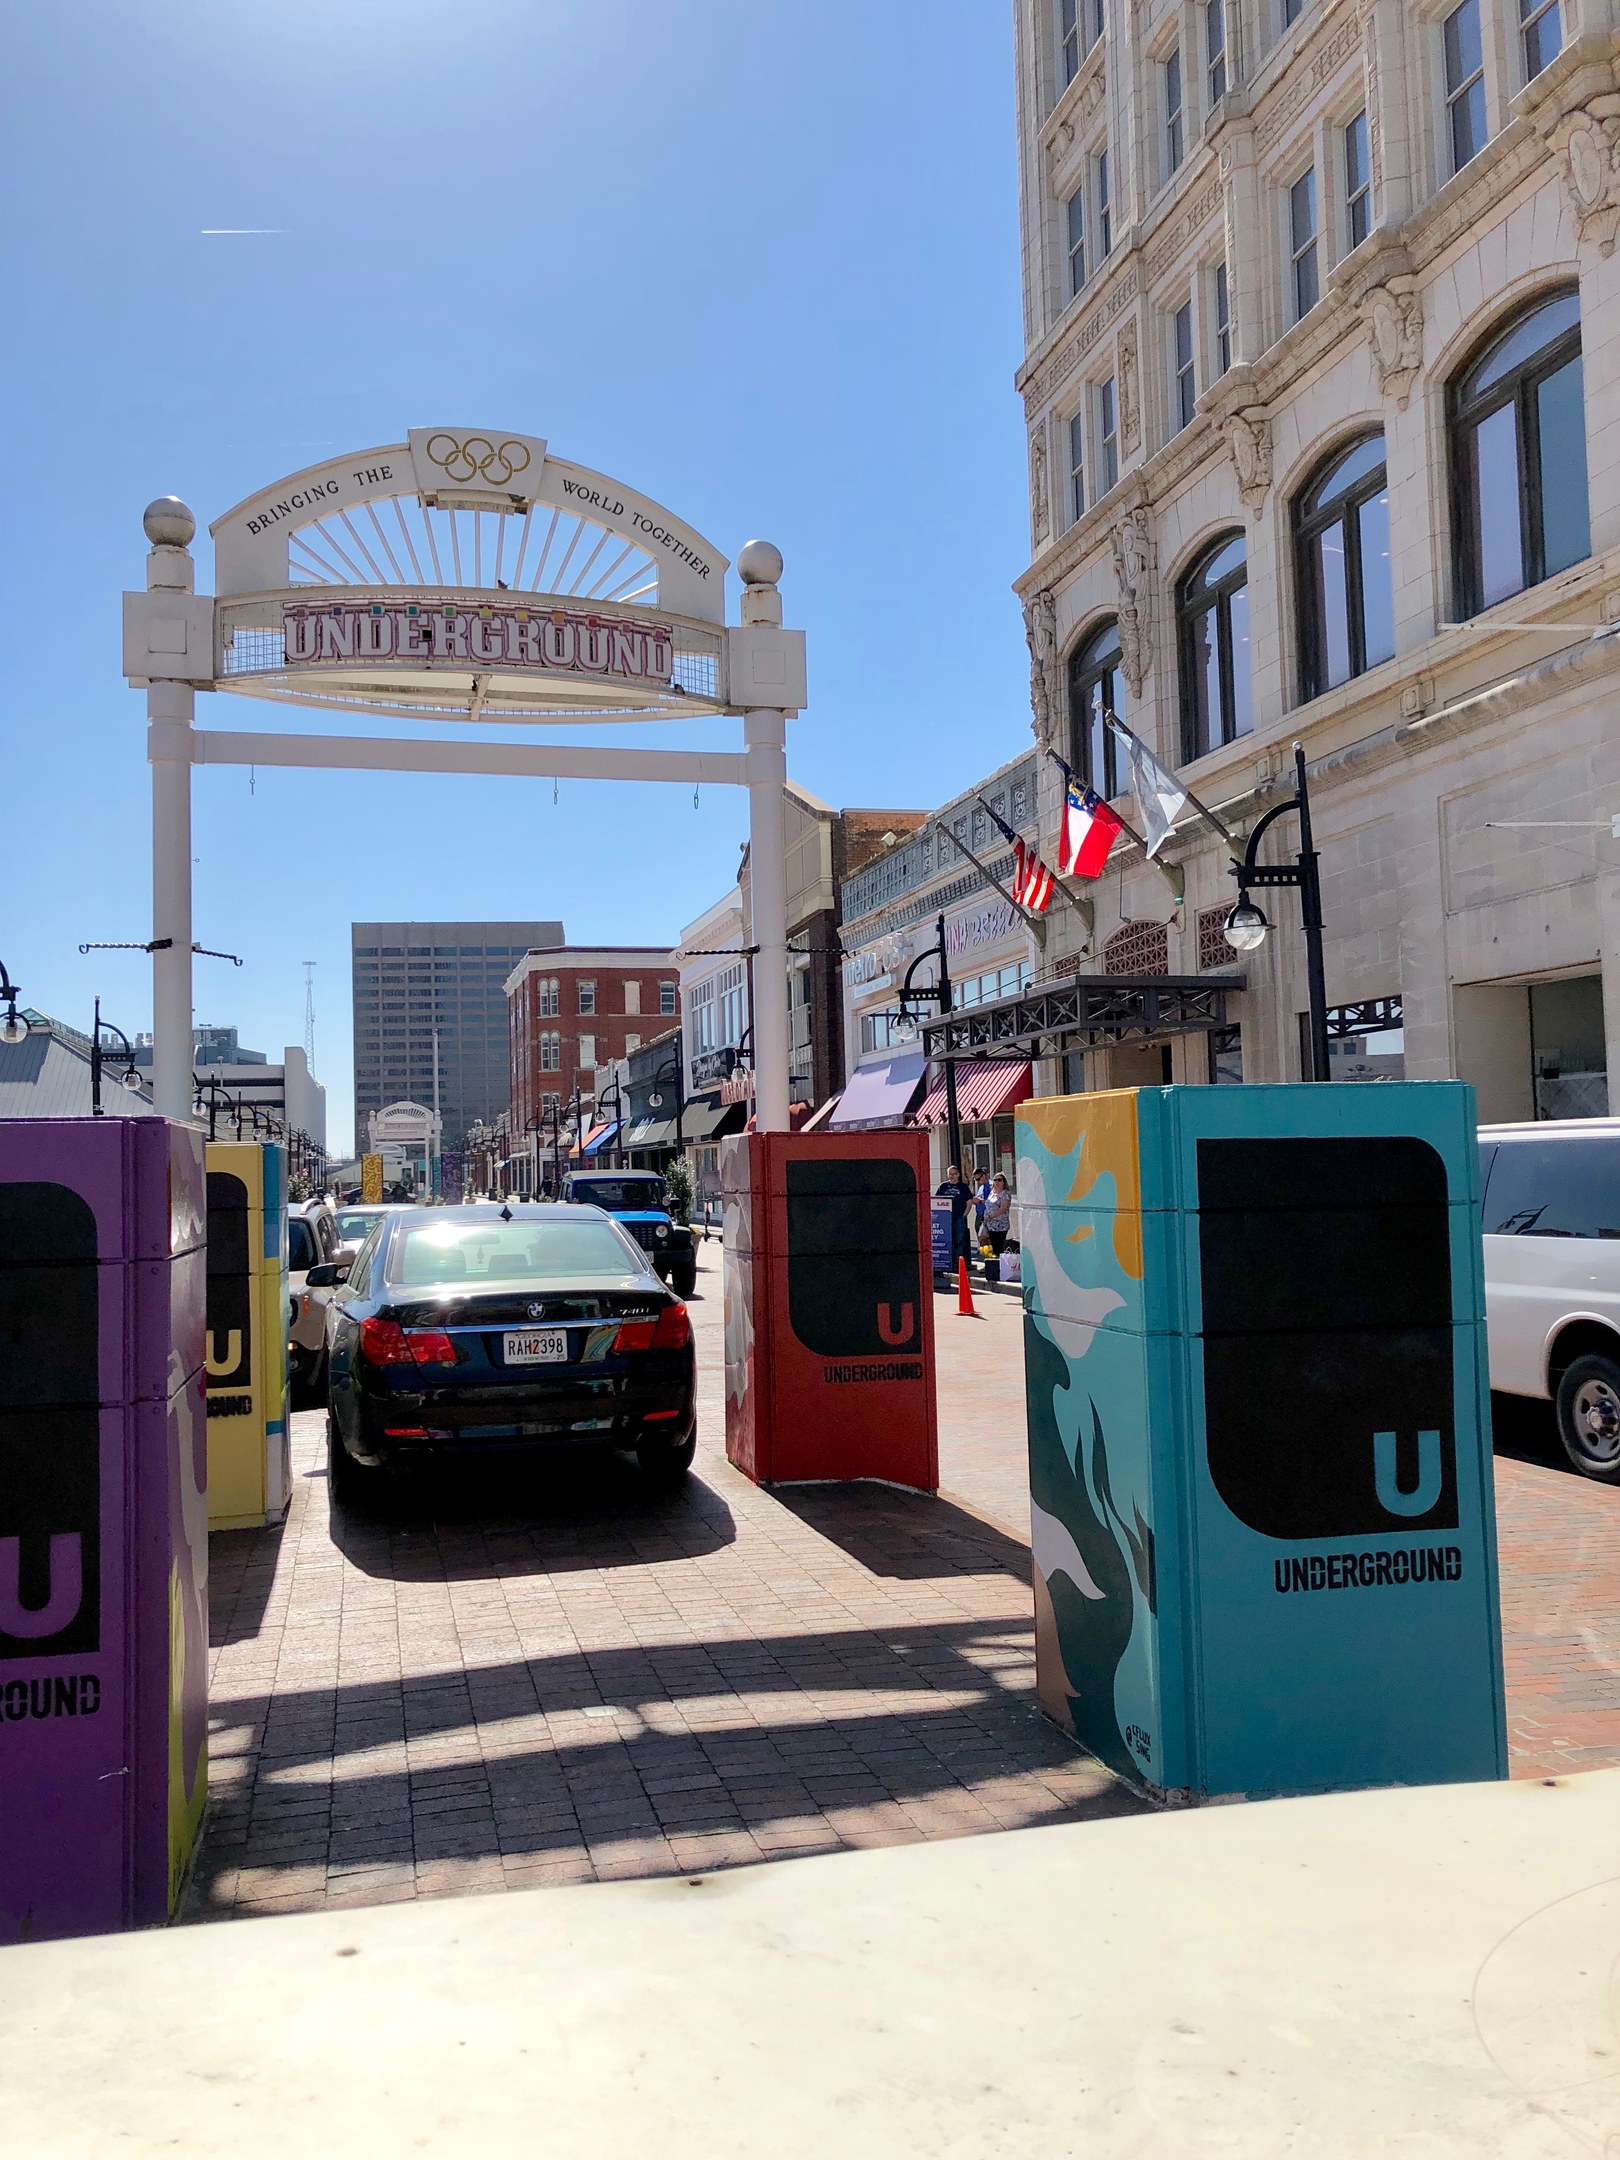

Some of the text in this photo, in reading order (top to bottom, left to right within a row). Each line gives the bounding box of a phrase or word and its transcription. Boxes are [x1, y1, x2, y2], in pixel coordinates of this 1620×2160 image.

[246, 465, 711, 580] BRINGING THE WORLD TOGETHER
[284, 606, 674, 681] UNDERGROUND
[518, 1331, 552, 1339] GEORGIA
[877, 1302, 914, 1345] U
[206, 1329, 242, 1376] U
[508, 1338, 564, 1356] RAH2398
[824, 1362, 923, 1384] UNDERGROUND
[1373, 1430, 1442, 1517] U
[1275, 1547, 1462, 1593] UNDERGROUND
